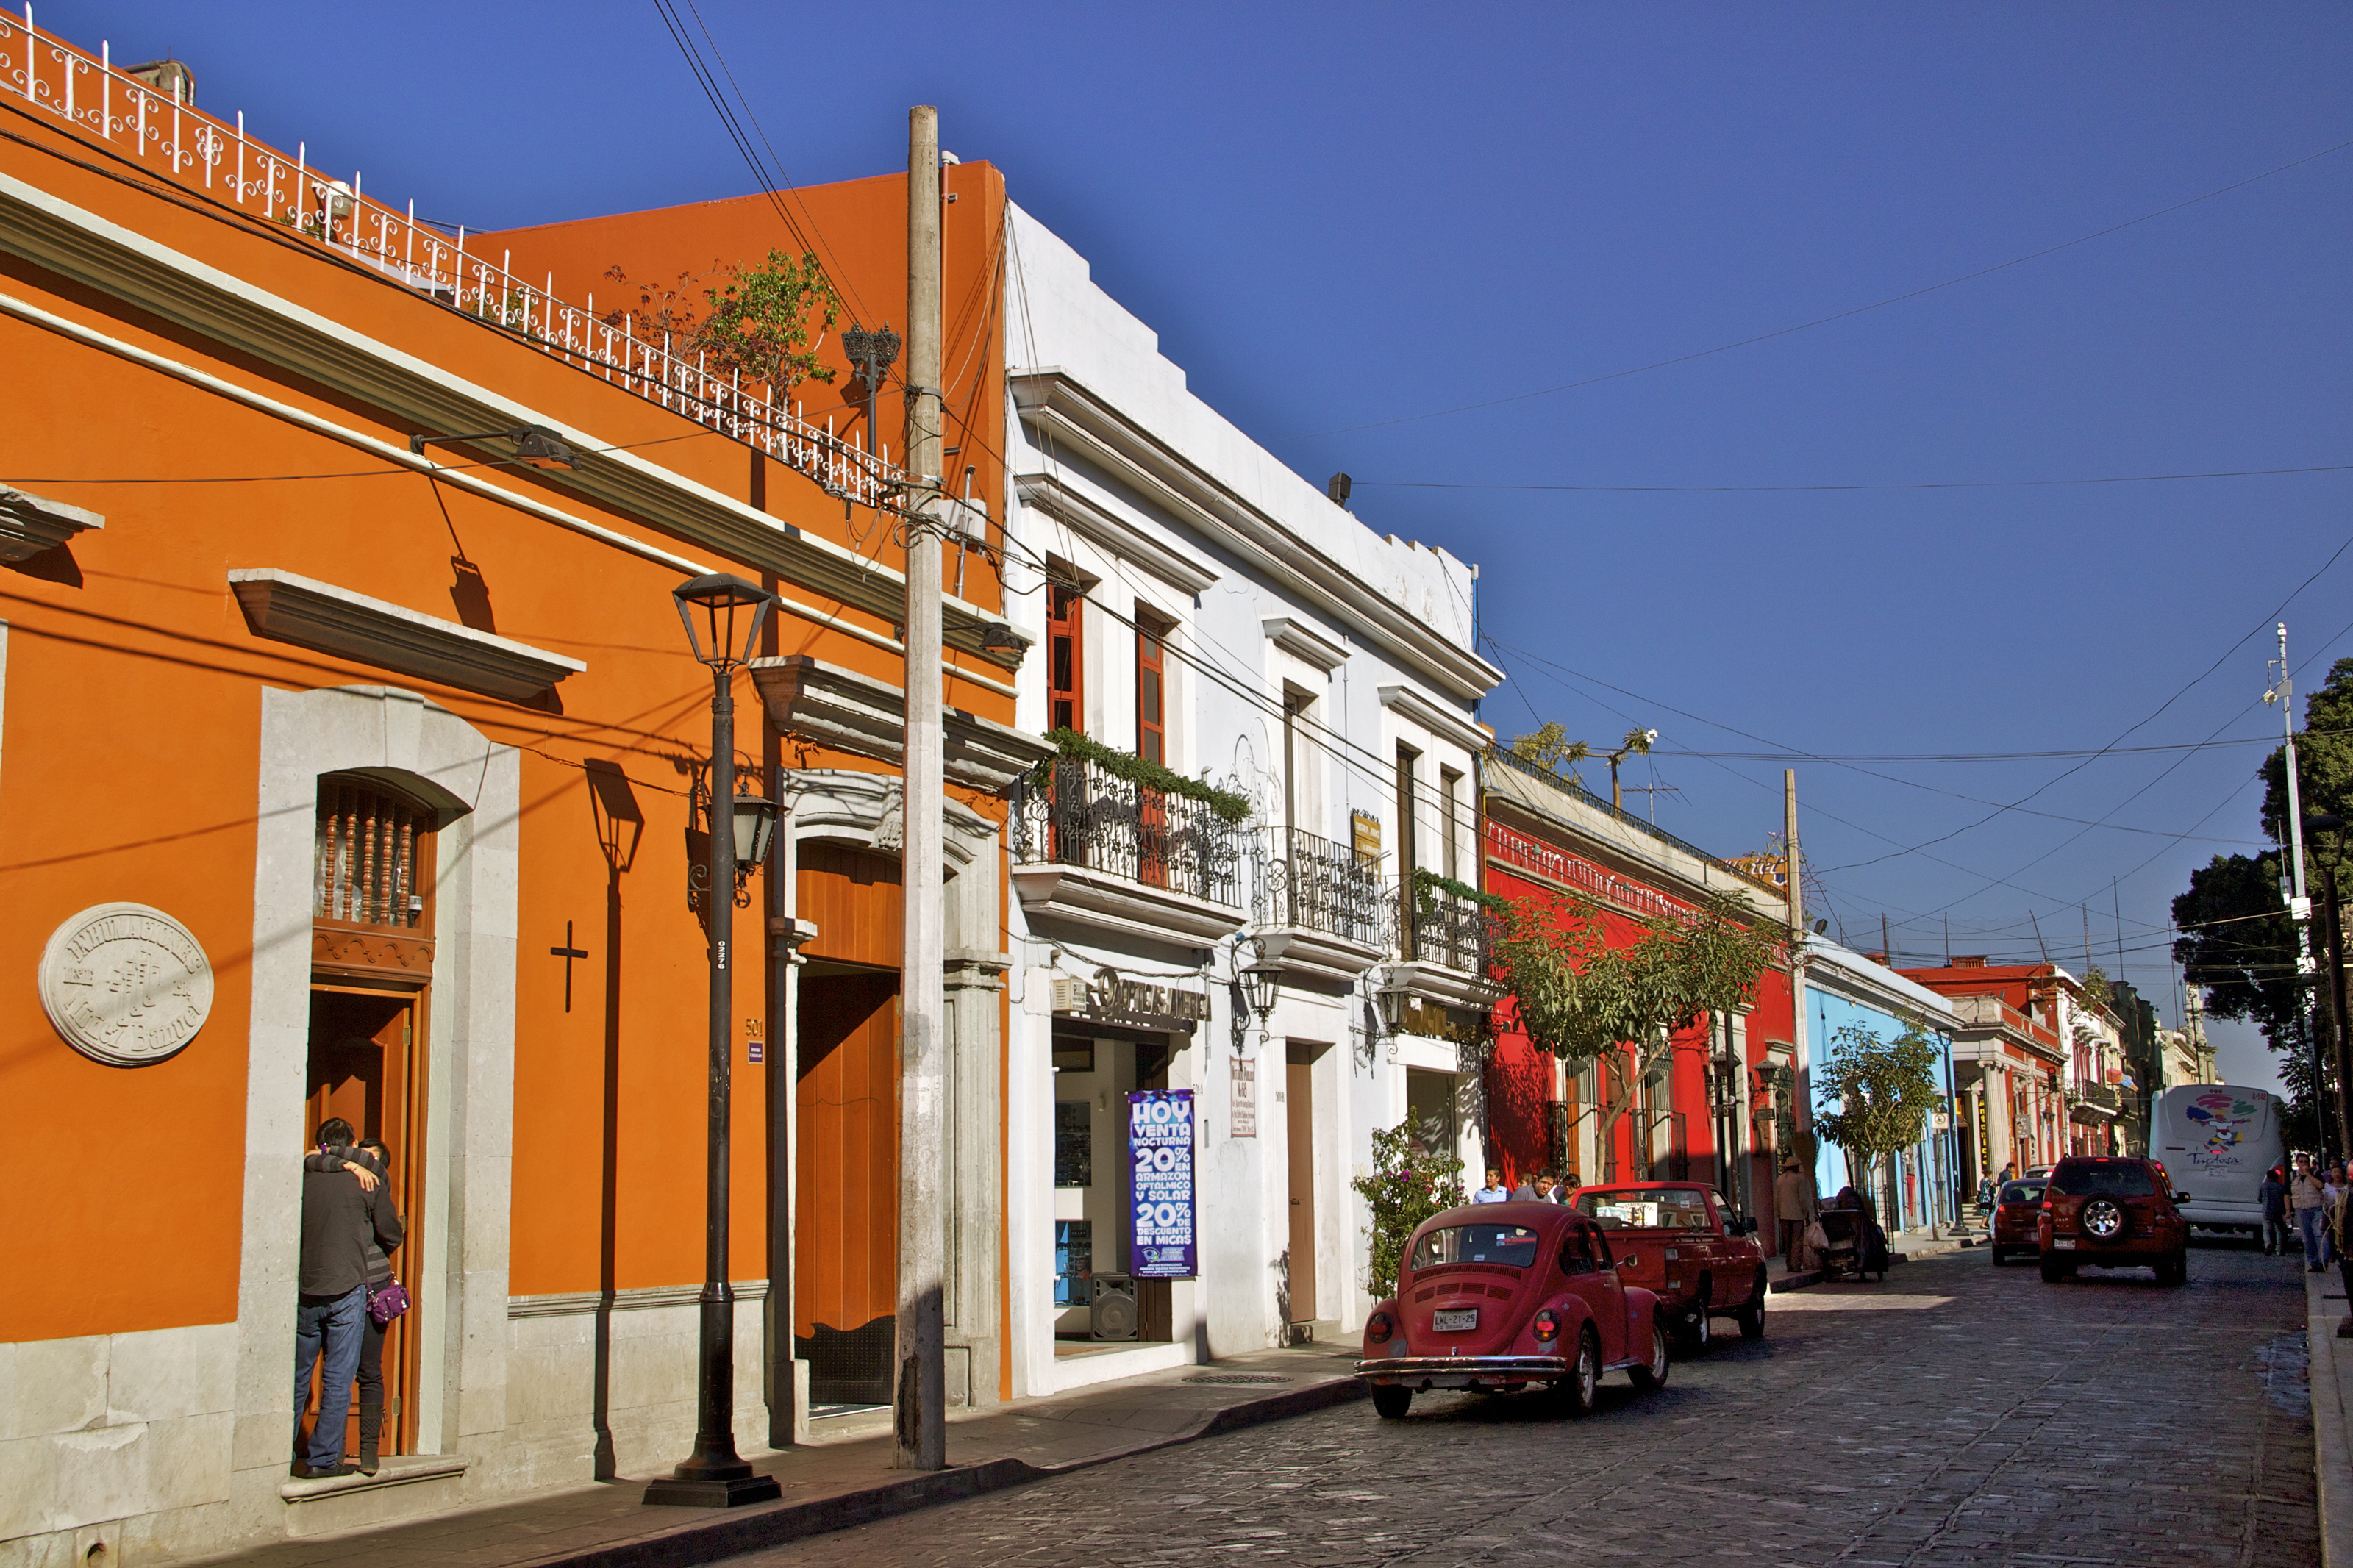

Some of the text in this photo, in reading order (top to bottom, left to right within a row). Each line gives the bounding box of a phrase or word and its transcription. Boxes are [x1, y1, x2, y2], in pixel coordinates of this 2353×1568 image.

[66, 917, 203, 974] INHUMACIONES
[718, 940, 726, 970] 02276
[1119, 978, 1167, 1015] OPTICAS
[746, 1018, 763, 1037] 501
[1133, 1100, 1190, 1125] HOY
[1134, 1123, 1190, 1138] VENTA
[1134, 1136, 1190, 1146] NOCTURNA
[1135, 1147, 1190, 1172] 20%
[1174, 1162, 1190, 1171] EN
[1135, 1172, 1190, 1182] ARMAZON
[1135, 1181, 1191, 1190] OFTALMICO
[1135, 1189, 1190, 1201] Y SOLAR
[1136, 1203, 1191, 1228] 20%
[1176, 1218, 1191, 1227] DE
[1137, 1227, 1192, 1235] DESCUENTO
[1137, 1234, 1192, 1245] EN MICAS
